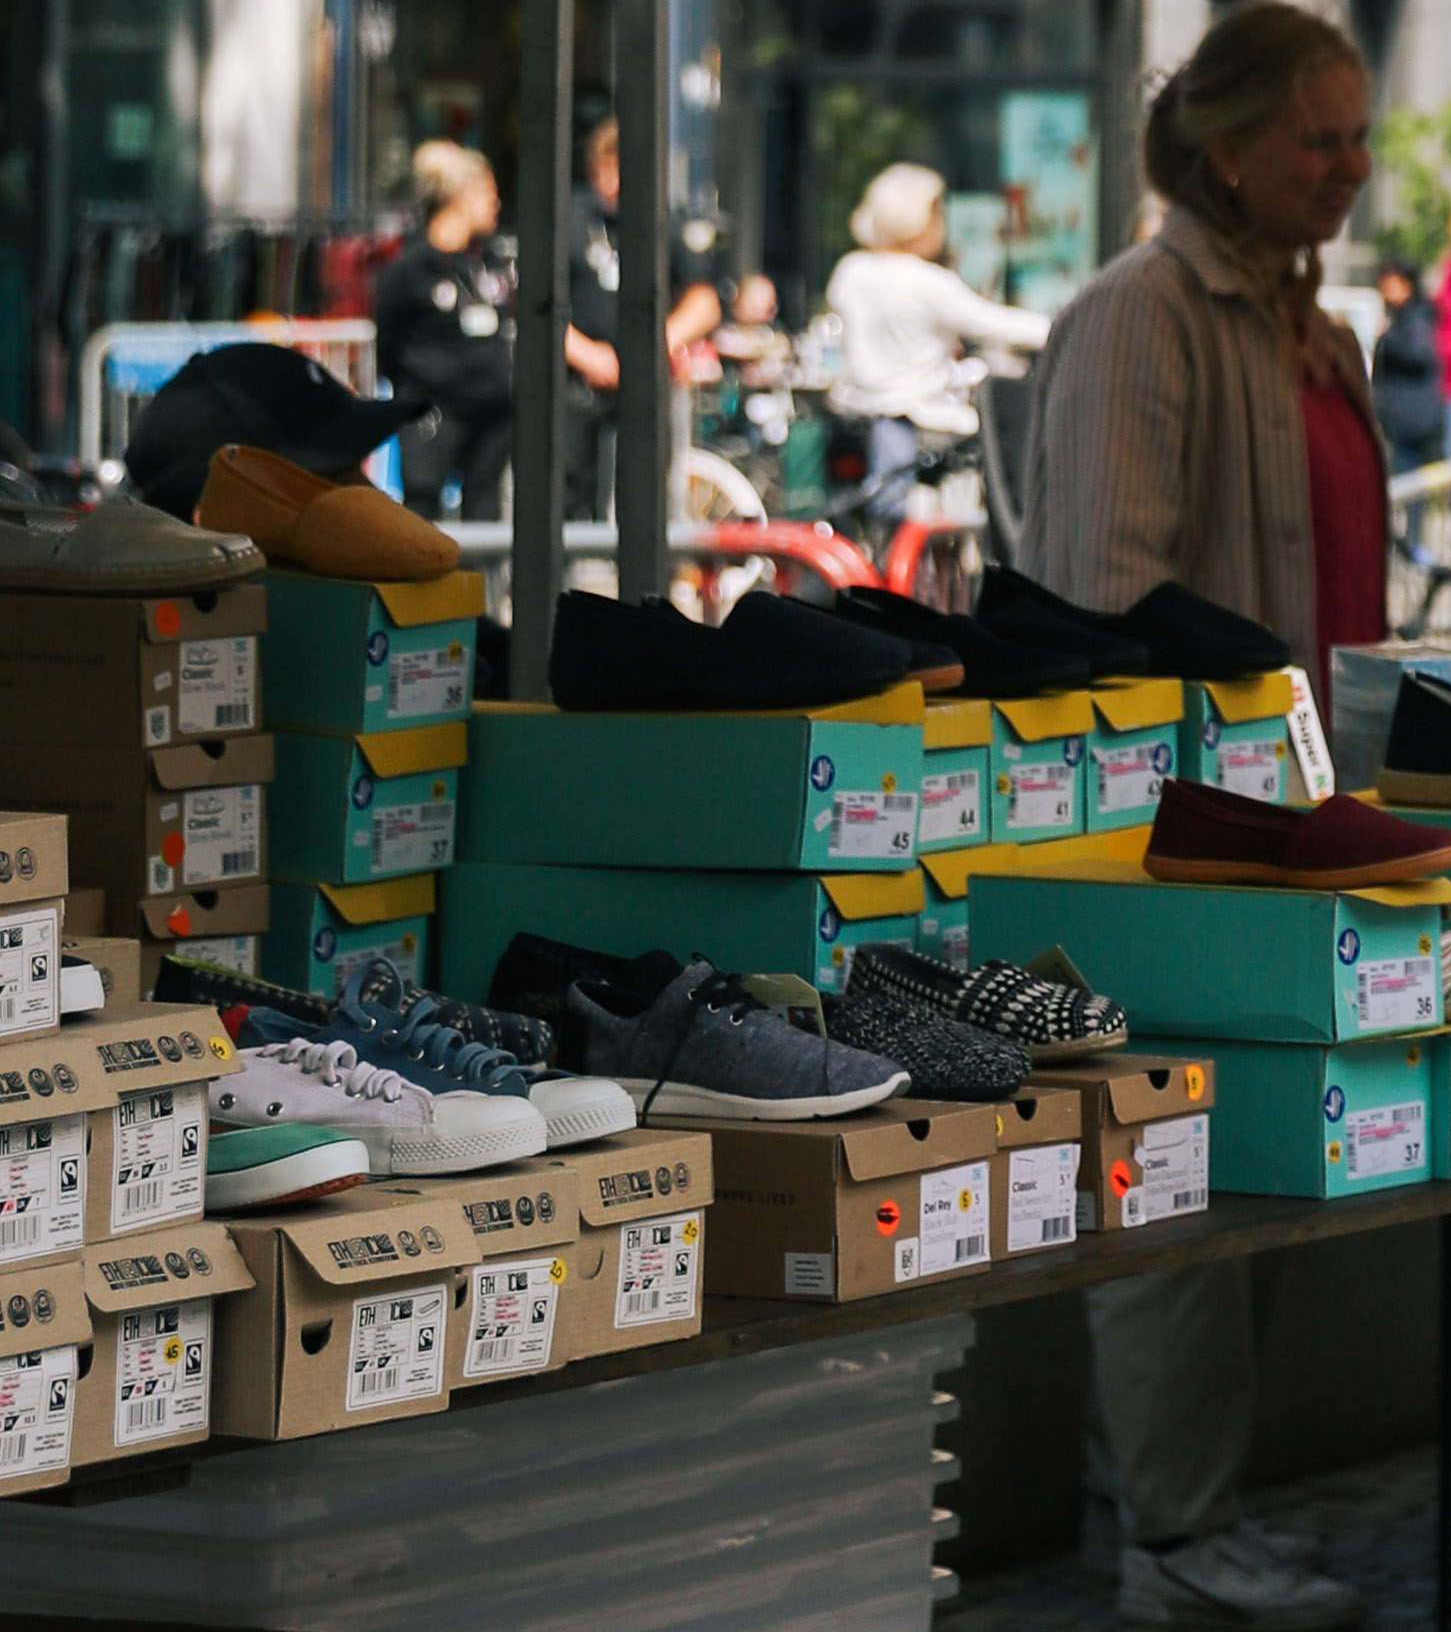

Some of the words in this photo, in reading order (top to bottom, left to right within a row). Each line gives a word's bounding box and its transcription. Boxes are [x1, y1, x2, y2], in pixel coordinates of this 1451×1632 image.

[1297, 711, 1321, 767] Super
[960, 809, 976, 827] 44
[1056, 801, 1069, 817] 41
[431, 839, 449, 858] 37
[892, 833, 910, 851] 45
[1417, 996, 1432, 1015] 36
[119, 1093, 160, 1128] ETHIC
[1405, 1143, 1420, 1162] 37
[599, 1172, 641, 1200] ETHIC
[1012, 1180, 1037, 1193] Classic
[924, 1202, 937, 1214] Del
[938, 1200, 951, 1212] Rey
[974, 1193, 980, 1205] 5
[327, 1234, 379, 1262] ETHIC
[627, 1227, 661, 1250] ETHIC
[98, 1256, 152, 1283] ETHIC
[480, 1273, 517, 1296] ETHIC
[359, 1300, 400, 1327] ETHIC
[123, 1309, 165, 1342] ETHIC
